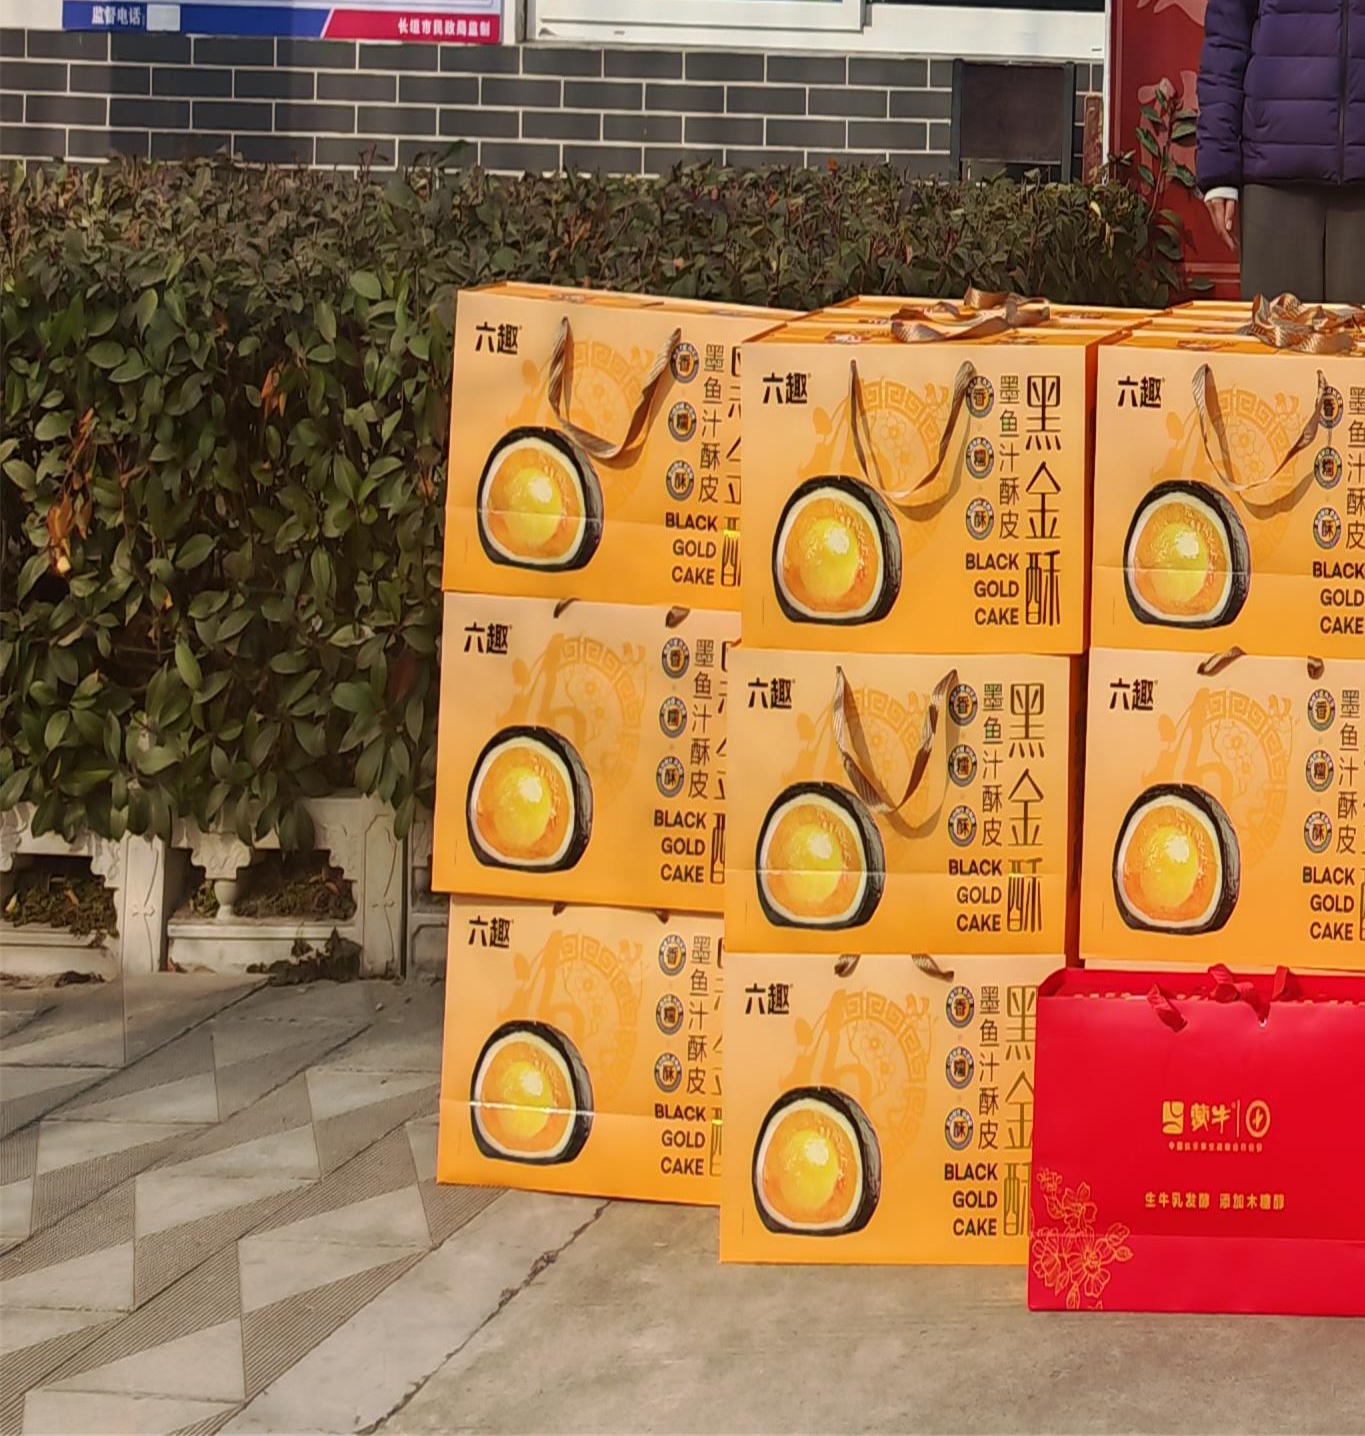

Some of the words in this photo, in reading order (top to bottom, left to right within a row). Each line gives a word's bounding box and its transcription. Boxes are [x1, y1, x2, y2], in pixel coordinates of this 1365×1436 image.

[397, 17, 491, 38] 长垣市民政局监制
[476, 322, 518, 354] 六趣
[763, 372, 808, 404] 六趣
[1118, 376, 1161, 408] 六趣
[699, 344, 724, 504] 墨鱼汁酥皮
[999, 375, 1019, 539] 墨鱼汁酥皮
[1026, 375, 1061, 626] 黑金酥
[665, 512, 717, 531] BLACK
[672, 539, 716, 558] GOLD
[966, 554, 1019, 570] BLACK
[1313, 561, 1365, 579] BLACK
[671, 566, 715, 585] CAKE
[974, 581, 1019, 598] GOLD
[1321, 589, 1364, 606] GOLD
[975, 608, 1019, 625] CAKE
[1320, 616, 1364, 634] CAKE
[464, 622, 508, 655] 六趣
[748, 677, 792, 709] 六趣
[1110, 678, 1154, 711] 六趣
[688, 639, 714, 800] 墨鱼汁酥皮
[982, 683, 1003, 847] 墨鱼汁酥皮
[1336, 690, 1360, 855] 墨鱼汁酥皮
[1007, 683, 1044, 932] 黑金酥
[654, 810, 707, 829] BLACK
[662, 837, 705, 856] GOLD
[661, 864, 704, 883] CAKE
[949, 859, 1002, 876] BLACK
[1302, 866, 1355, 885] BLACK
[957, 886, 1002, 904] GOLD
[1310, 894, 1354, 912] GOLD
[468, 916, 510, 948] 六趣
[956, 914, 1001, 932] CAKE
[1310, 922, 1354, 940] CAKE
[745, 983, 789, 1014] 六趣
[686, 936, 711, 1095] 墨鱼汁酥皮
[978, 986, 1000, 1151] 墨鱼汁酥皮
[654, 1104, 706, 1122] BLACK
[1191, 1103, 1231, 1134] 蒙牛
[662, 1130, 705, 1148] GOLD
[660, 1156, 704, 1175] CAKE
[944, 1163, 998, 1181] BLACK
[953, 1190, 997, 1208] GOLD
[1145, 1192, 1210, 1208] 生牛乳发酵
[953, 1218, 997, 1236] CAKE
